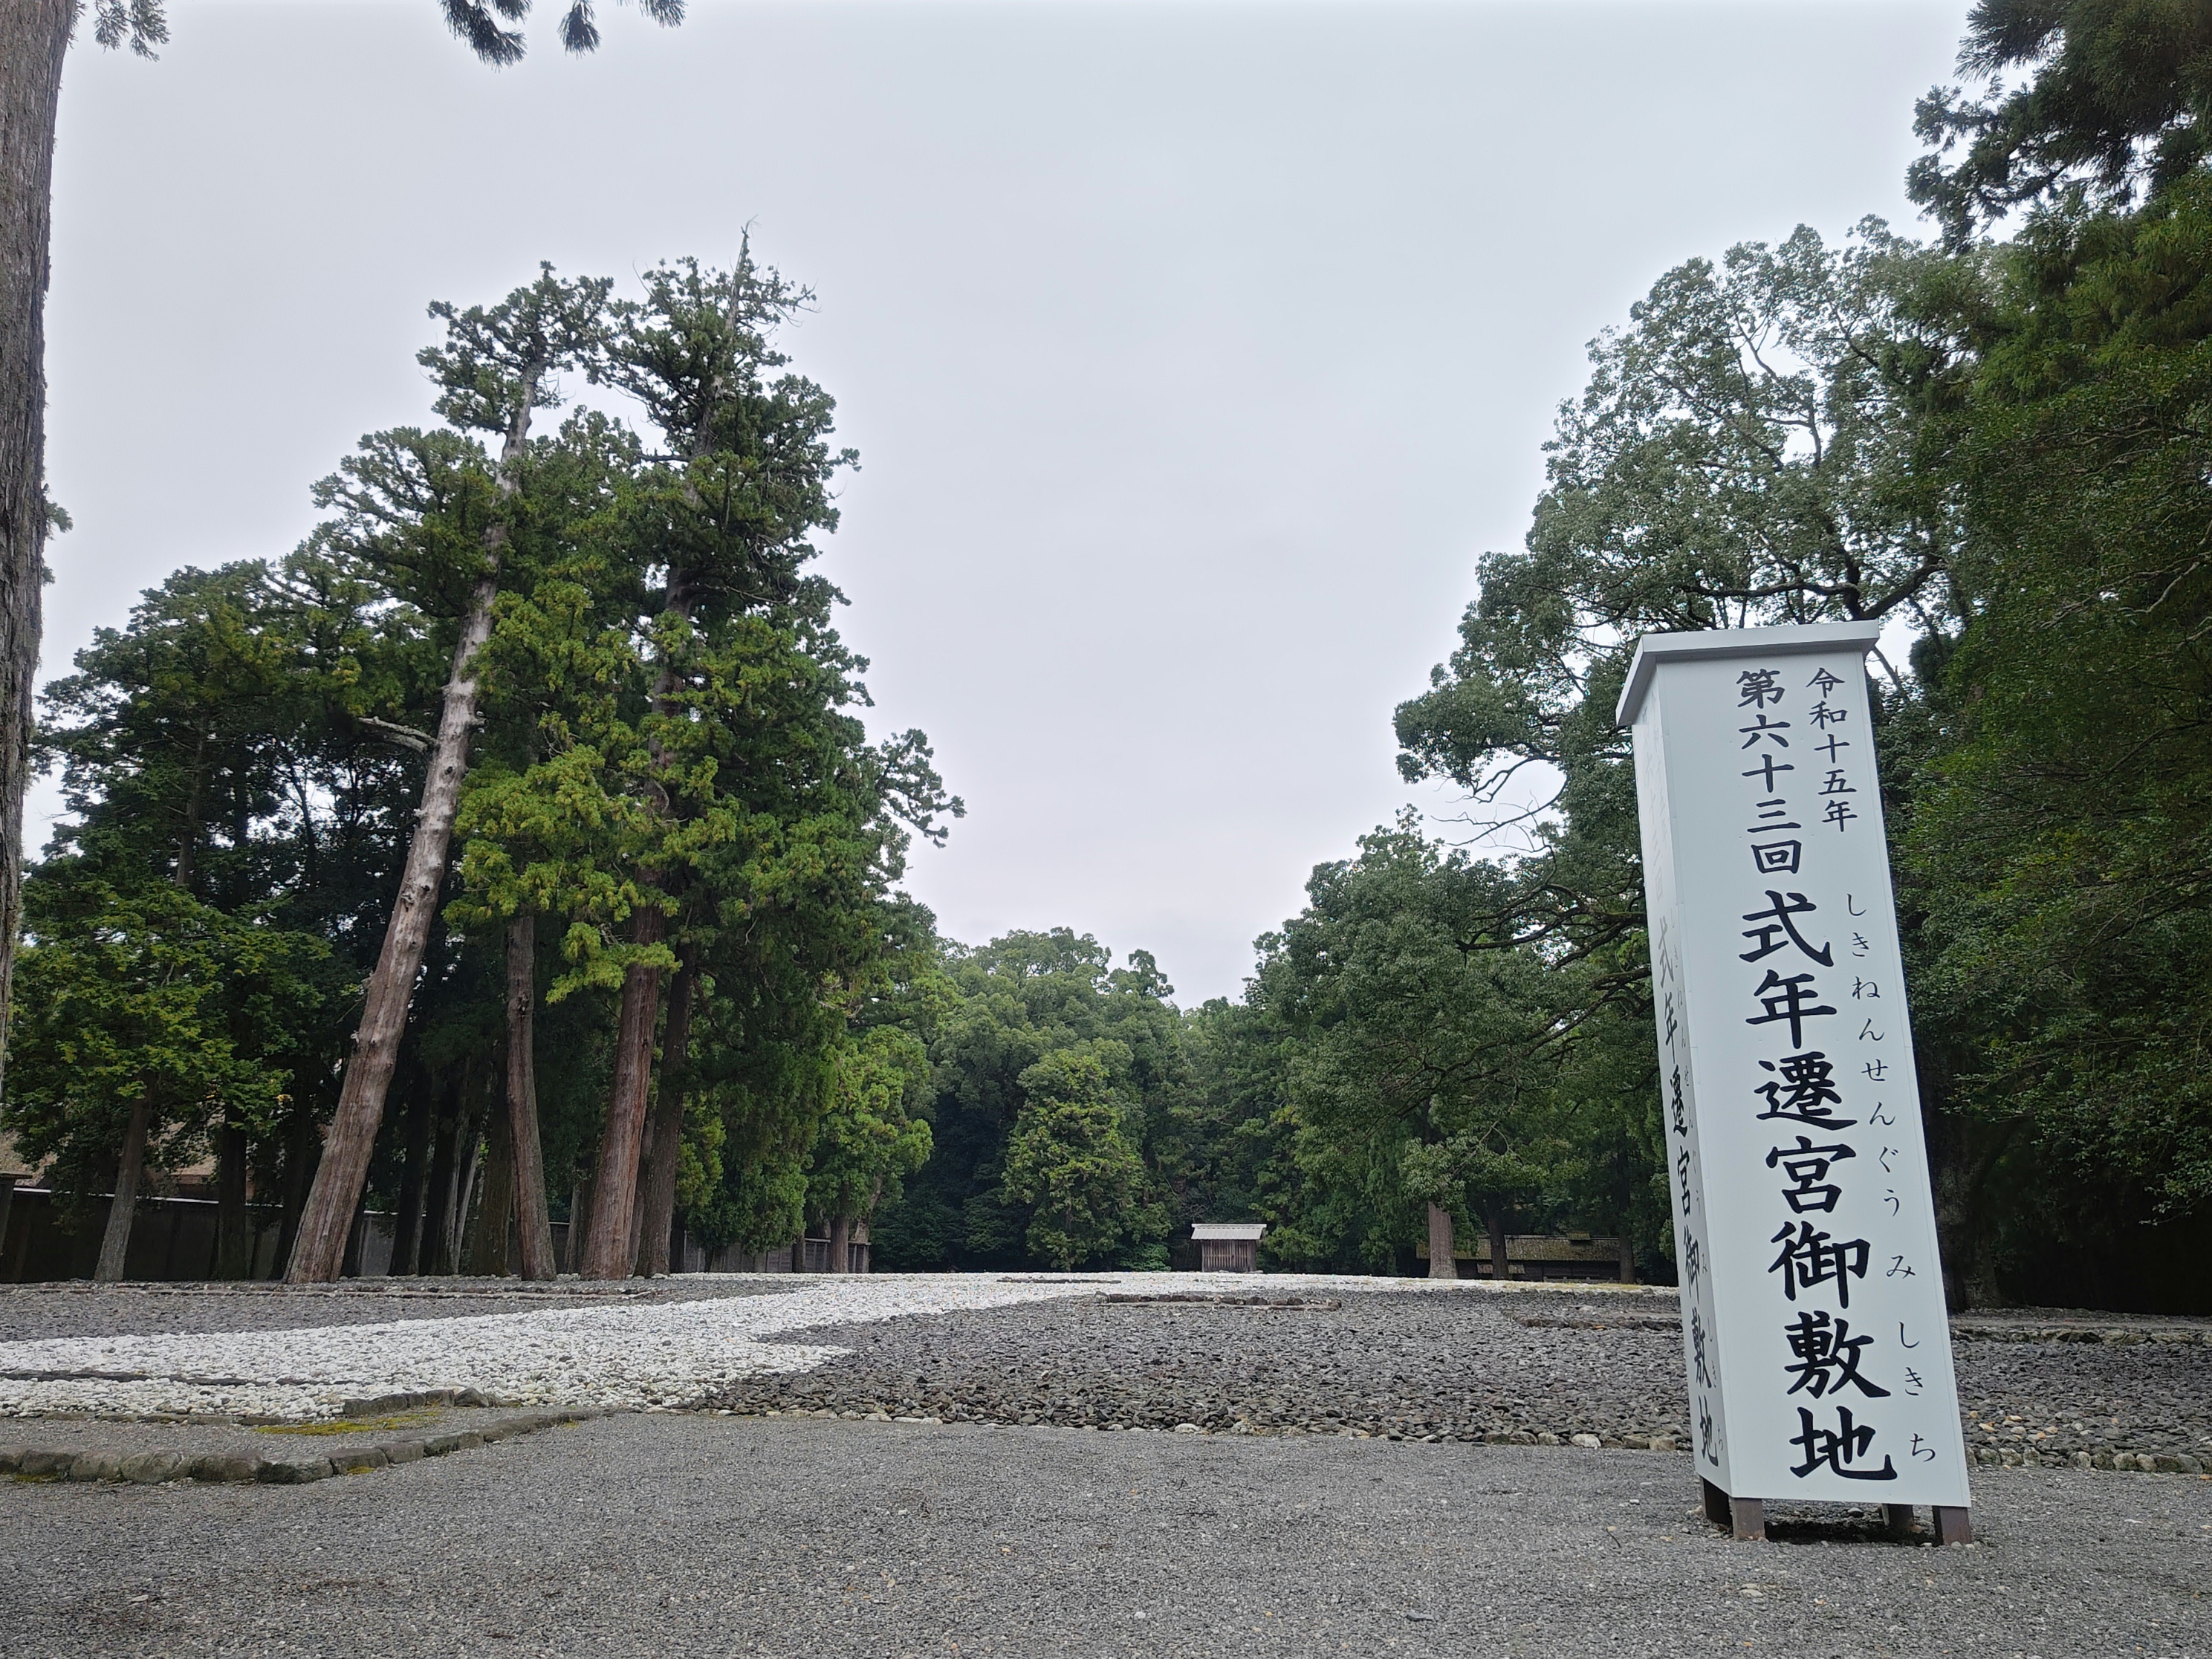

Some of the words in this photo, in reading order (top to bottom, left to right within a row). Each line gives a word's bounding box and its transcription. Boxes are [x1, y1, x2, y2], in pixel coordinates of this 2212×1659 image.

[1806, 668, 1858, 832] 令和十五年
